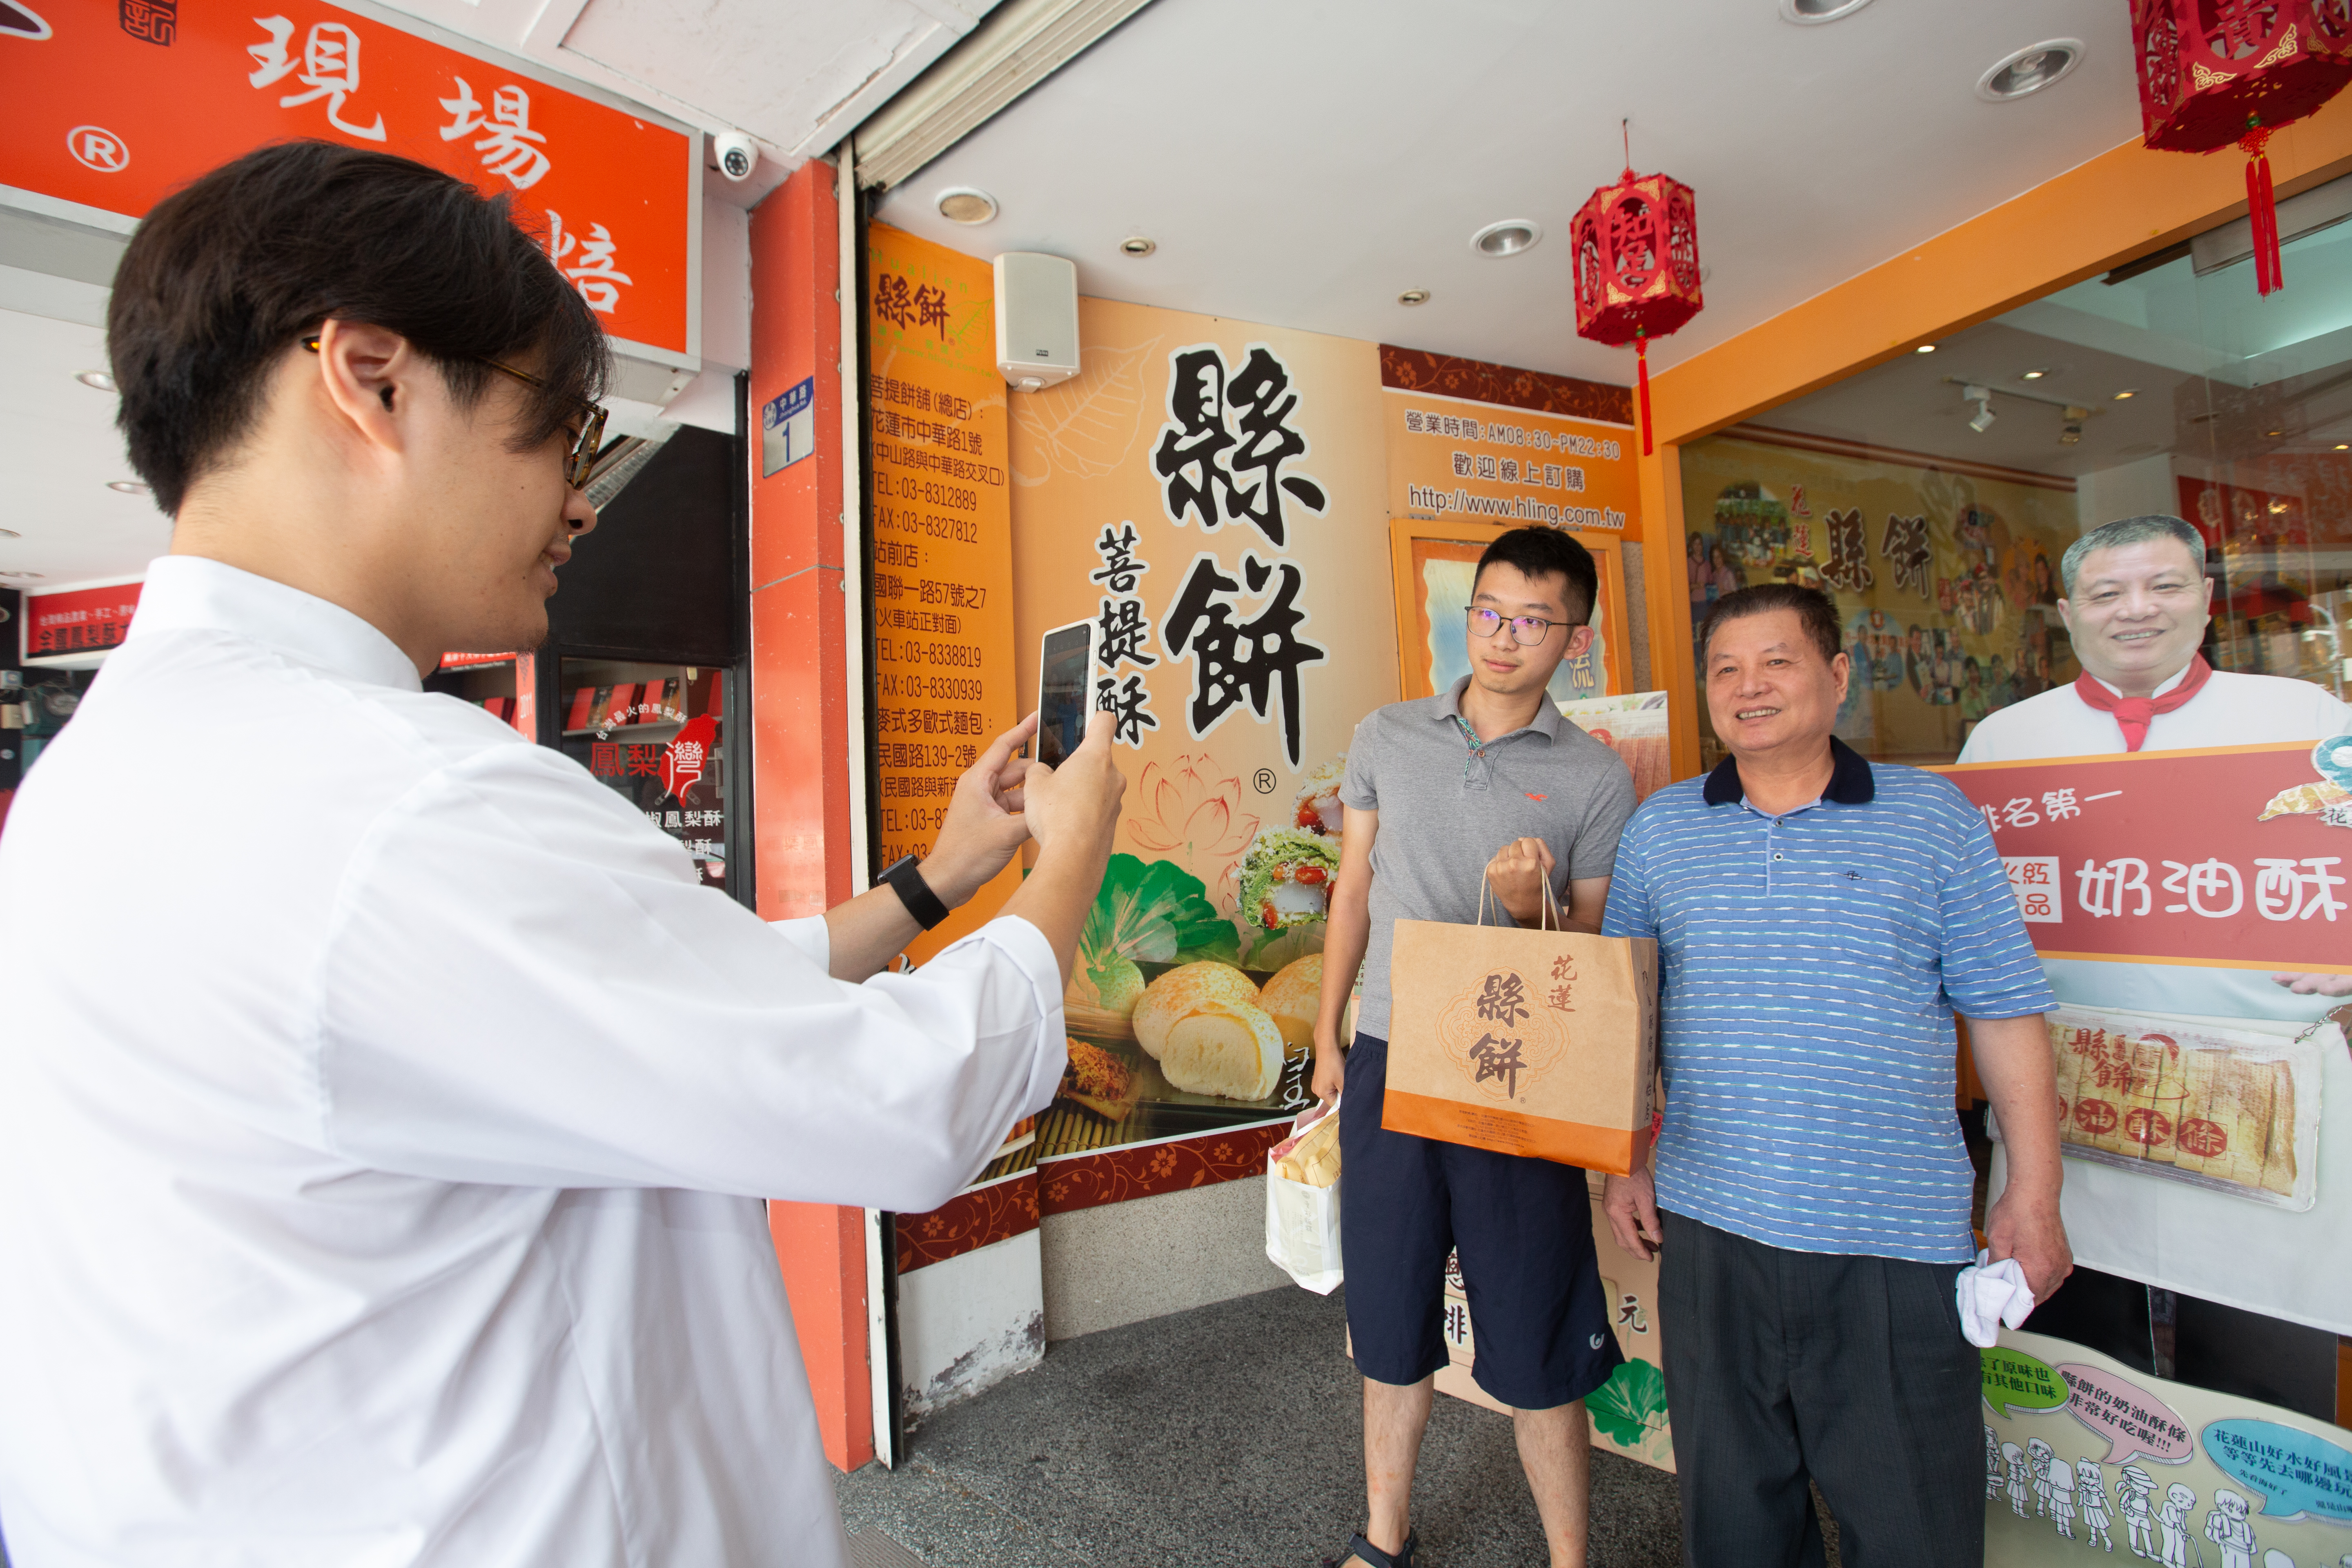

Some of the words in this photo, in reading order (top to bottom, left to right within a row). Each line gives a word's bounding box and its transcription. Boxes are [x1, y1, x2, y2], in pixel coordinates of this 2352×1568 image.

[246, 14, 550, 189] 現場
[874, 273, 951, 342] 縣餅
[782, 421, 790, 462] 1
[871, 407, 982, 456] 花蓮市中華路1號
[1453, 452, 1585, 492] 歡迎線上訂購
[1409, 484, 1625, 528] http://www.hling.com.tw
[1156, 348, 1325, 766] 縣餅
[875, 573, 986, 609] 國聯一路57號之7
[1094, 525, 1158, 744] 菩提酥
[596, 703, 687, 740] 台灣最火的鳳梨酥
[879, 743, 976, 768] 民國路139-2號
[2015, 893, 2051, 915] 品
[2075, 857, 2347, 922] 奶油酥
[1548, 954, 1577, 1012] 花蓮
[1470, 973, 1530, 1099] 縣餅
[2059, 1104, 2225, 1154] 油酥條
[2062, 1370, 2186, 1443] 縣餅的奶油酥條
